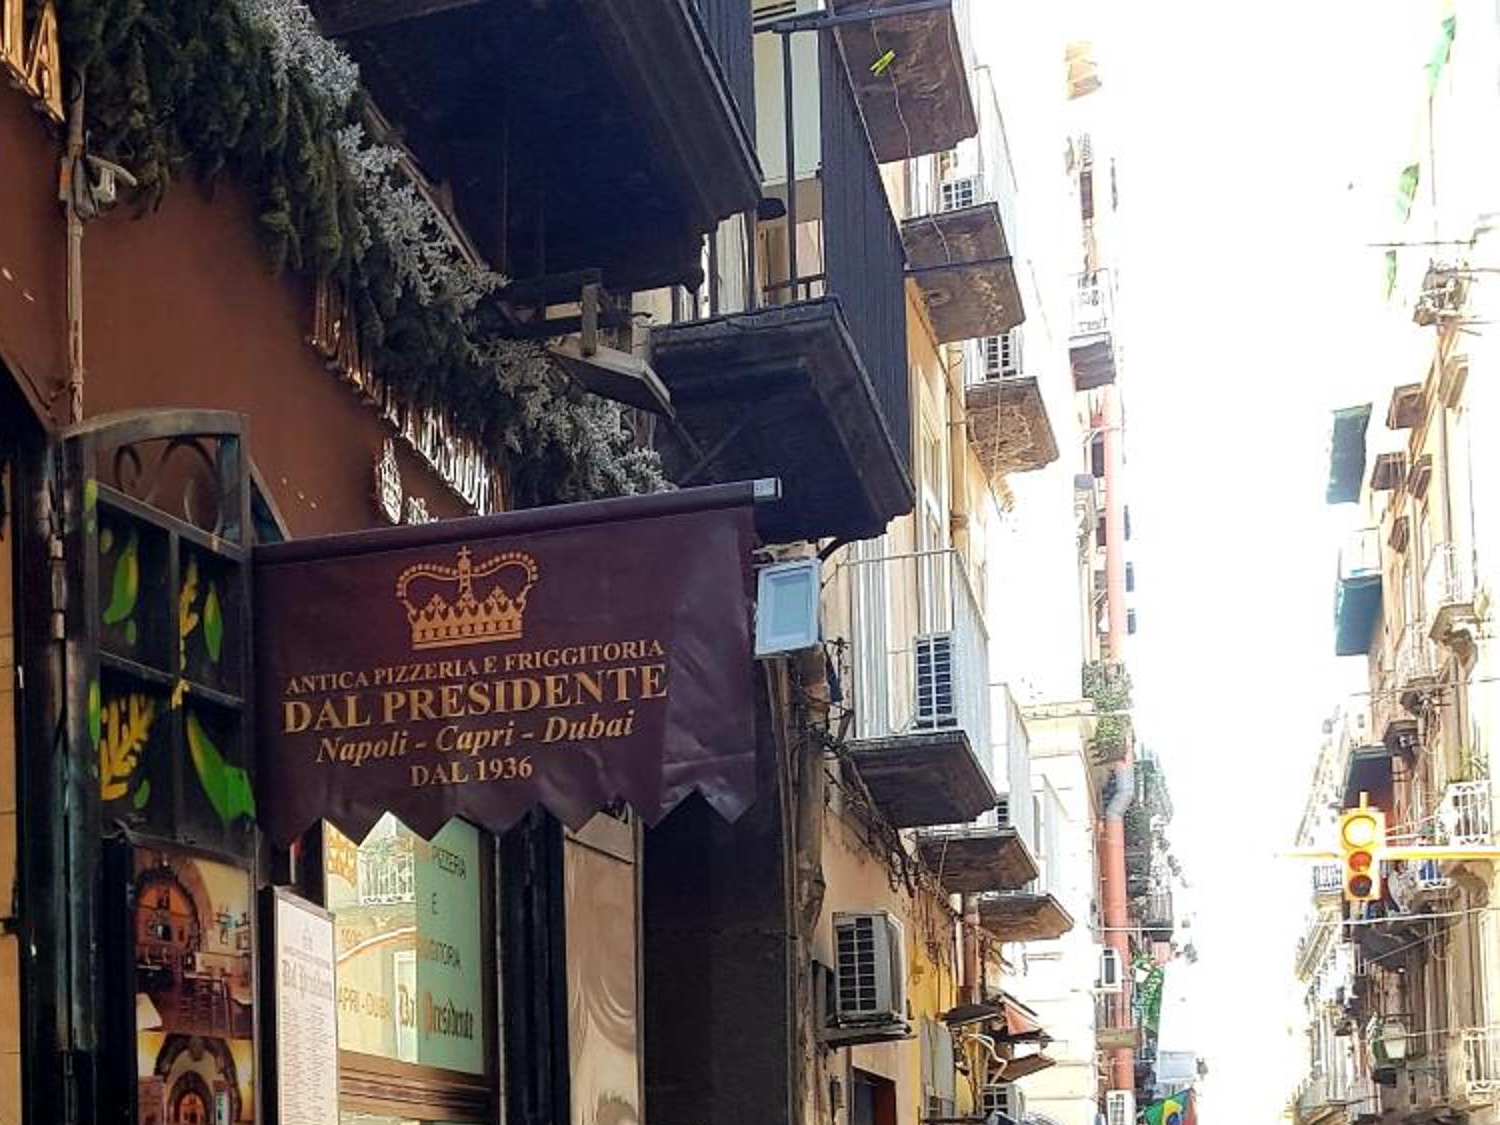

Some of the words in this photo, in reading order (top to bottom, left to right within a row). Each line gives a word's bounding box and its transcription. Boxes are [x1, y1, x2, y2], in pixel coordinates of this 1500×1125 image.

[284, 668, 369, 696] ANTICA
[373, 658, 477, 686] PIZZERIA
[484, 657, 497, 673] E
[503, 637, 665, 673] FRIGGITORIA
[283, 694, 372, 734] DAL
[383, 663, 668, 725] PRESIDENTE
[317, 732, 408, 765] Napoli
[435, 721, 515, 757] Capri
[543, 708, 635, 743] Dubai
[411, 764, 469, 787] DAL
[476, 756, 533, 783] 1936
